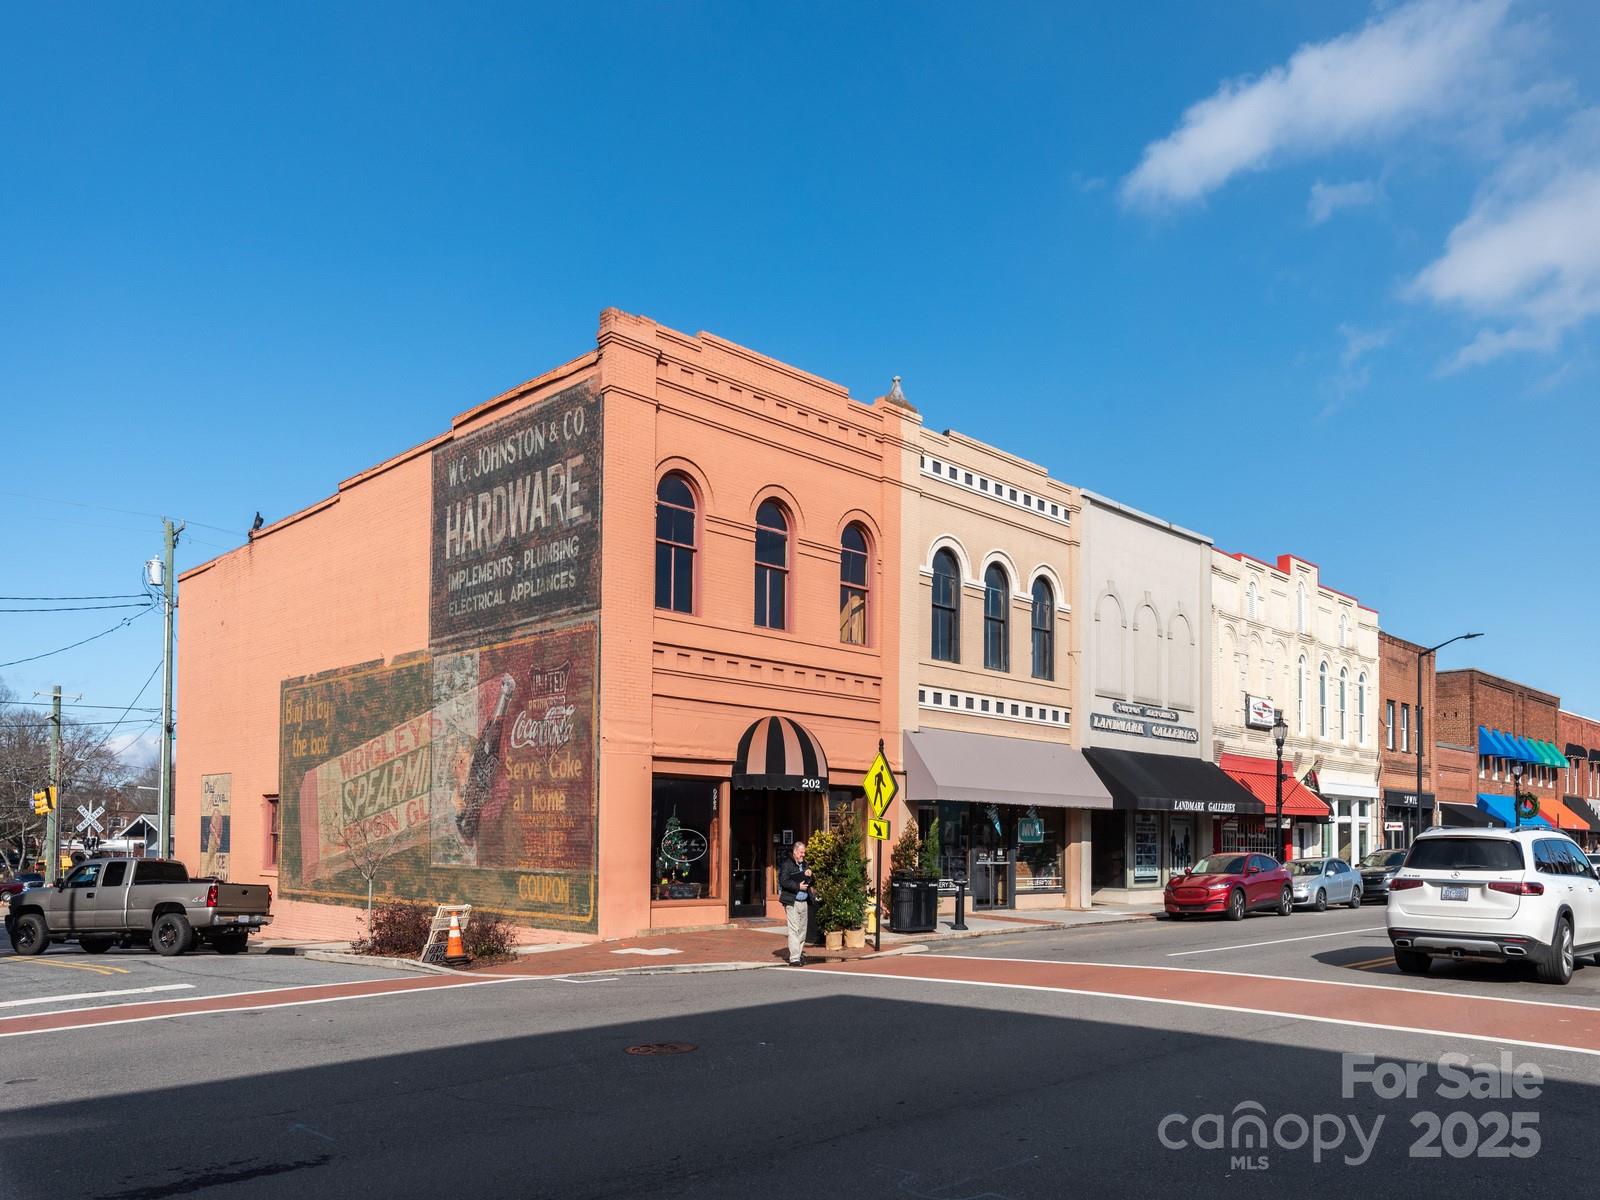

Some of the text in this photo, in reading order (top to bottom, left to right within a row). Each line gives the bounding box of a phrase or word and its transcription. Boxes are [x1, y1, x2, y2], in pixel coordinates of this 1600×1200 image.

[474, 422, 545, 477] JOHNSTON
[549, 421, 558, 442] &
[563, 406, 588, 440] CO.
[445, 454, 587, 559] HARDWARE
[448, 555, 513, 592] IMPLEMENTS
[523, 535, 579, 571] PLUMBING
[449, 569, 576, 617] ELECTRICAL APPLIANCES
[1094, 716, 1197, 741] LANDMARK GALLERIES
[505, 756, 541, 779] Serve
[548, 752, 582, 778] Coke
[801, 778, 821, 789] 202
[513, 785, 566, 811] at home
[1174, 800, 1236, 813] LANDMARK GALLERIES
[519, 874, 569, 904] COUPON
